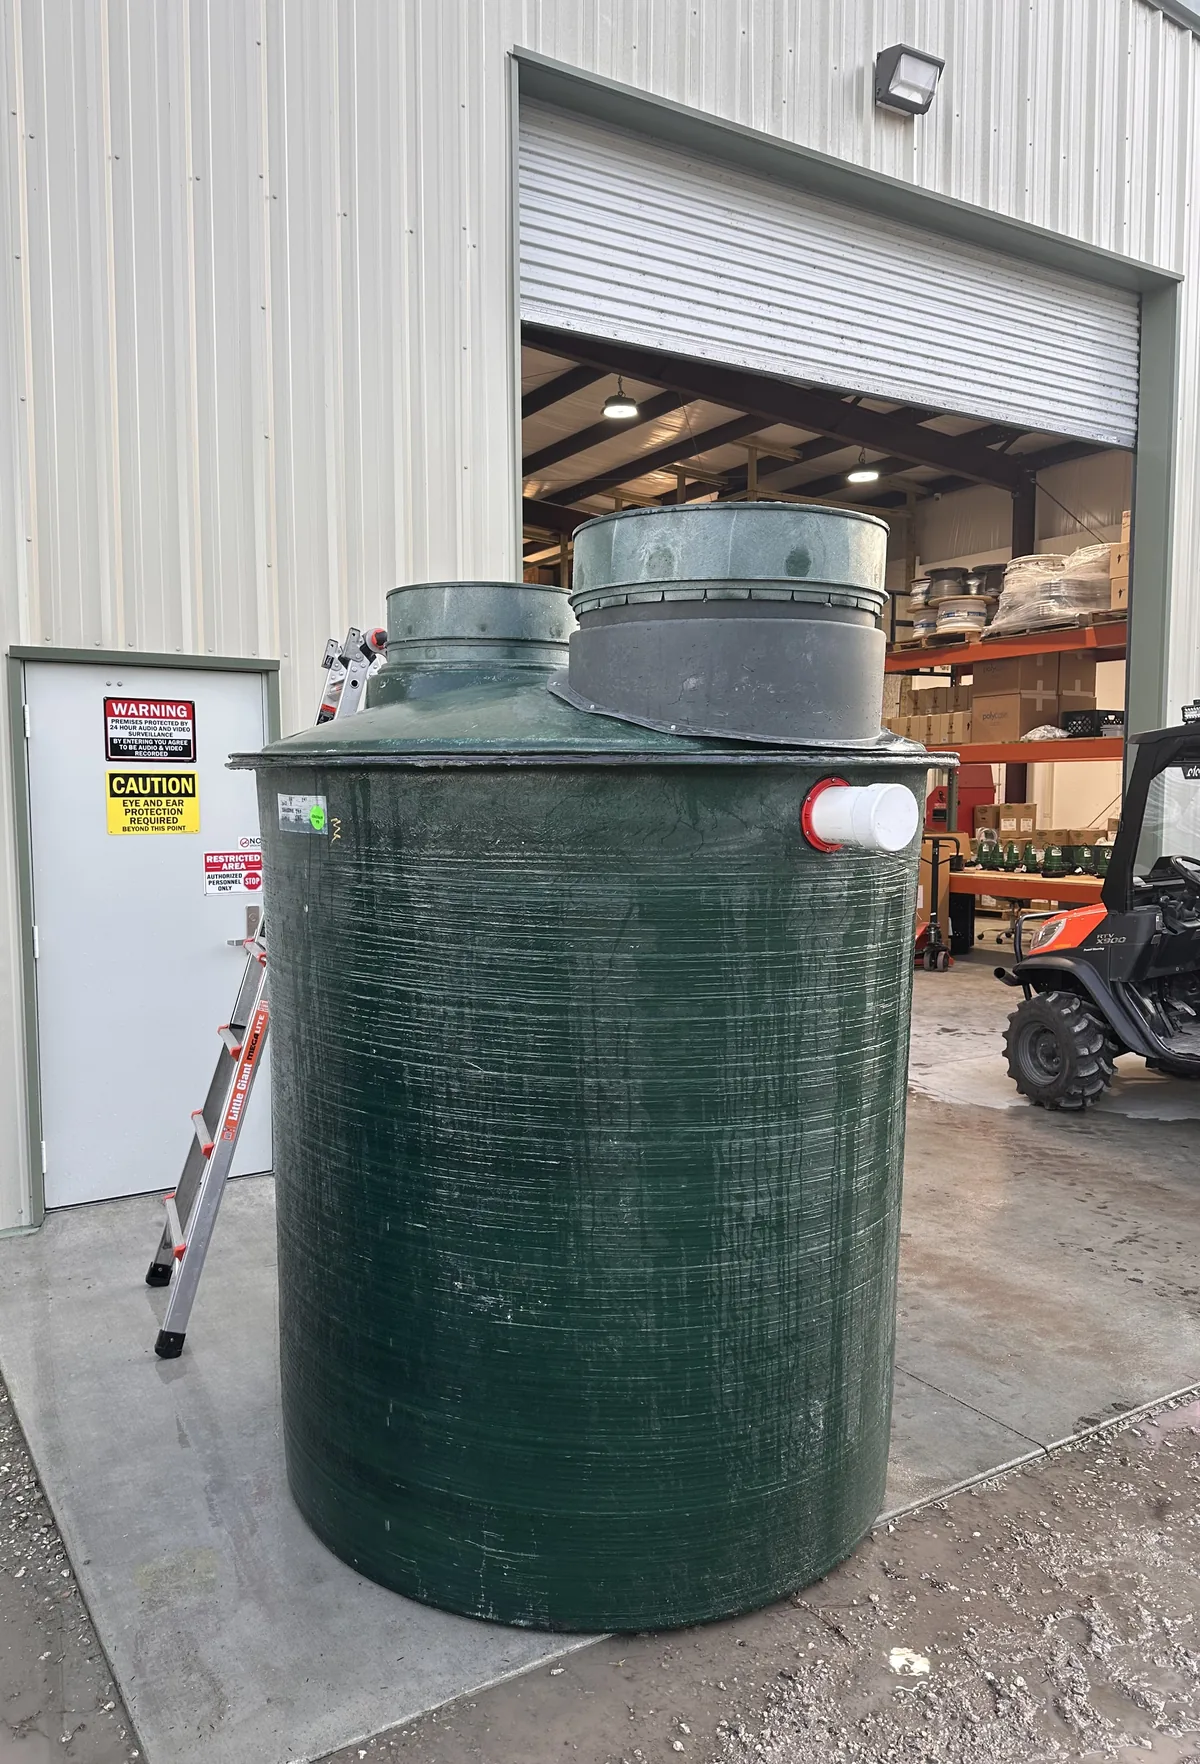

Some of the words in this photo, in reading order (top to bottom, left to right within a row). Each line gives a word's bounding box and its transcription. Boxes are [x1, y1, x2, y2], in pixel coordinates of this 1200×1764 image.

[112, 703, 187, 717] WARNING
[112, 777, 193, 794] CAUTION
[125, 808, 183, 816] PROTECTION
[130, 817, 178, 825] REQUIRED
[206, 854, 260, 863] RESTRICTED
[245, 877, 260, 885] STOP
[228, 1093, 244, 1120] Little
[237, 1063, 252, 1090] Giant
